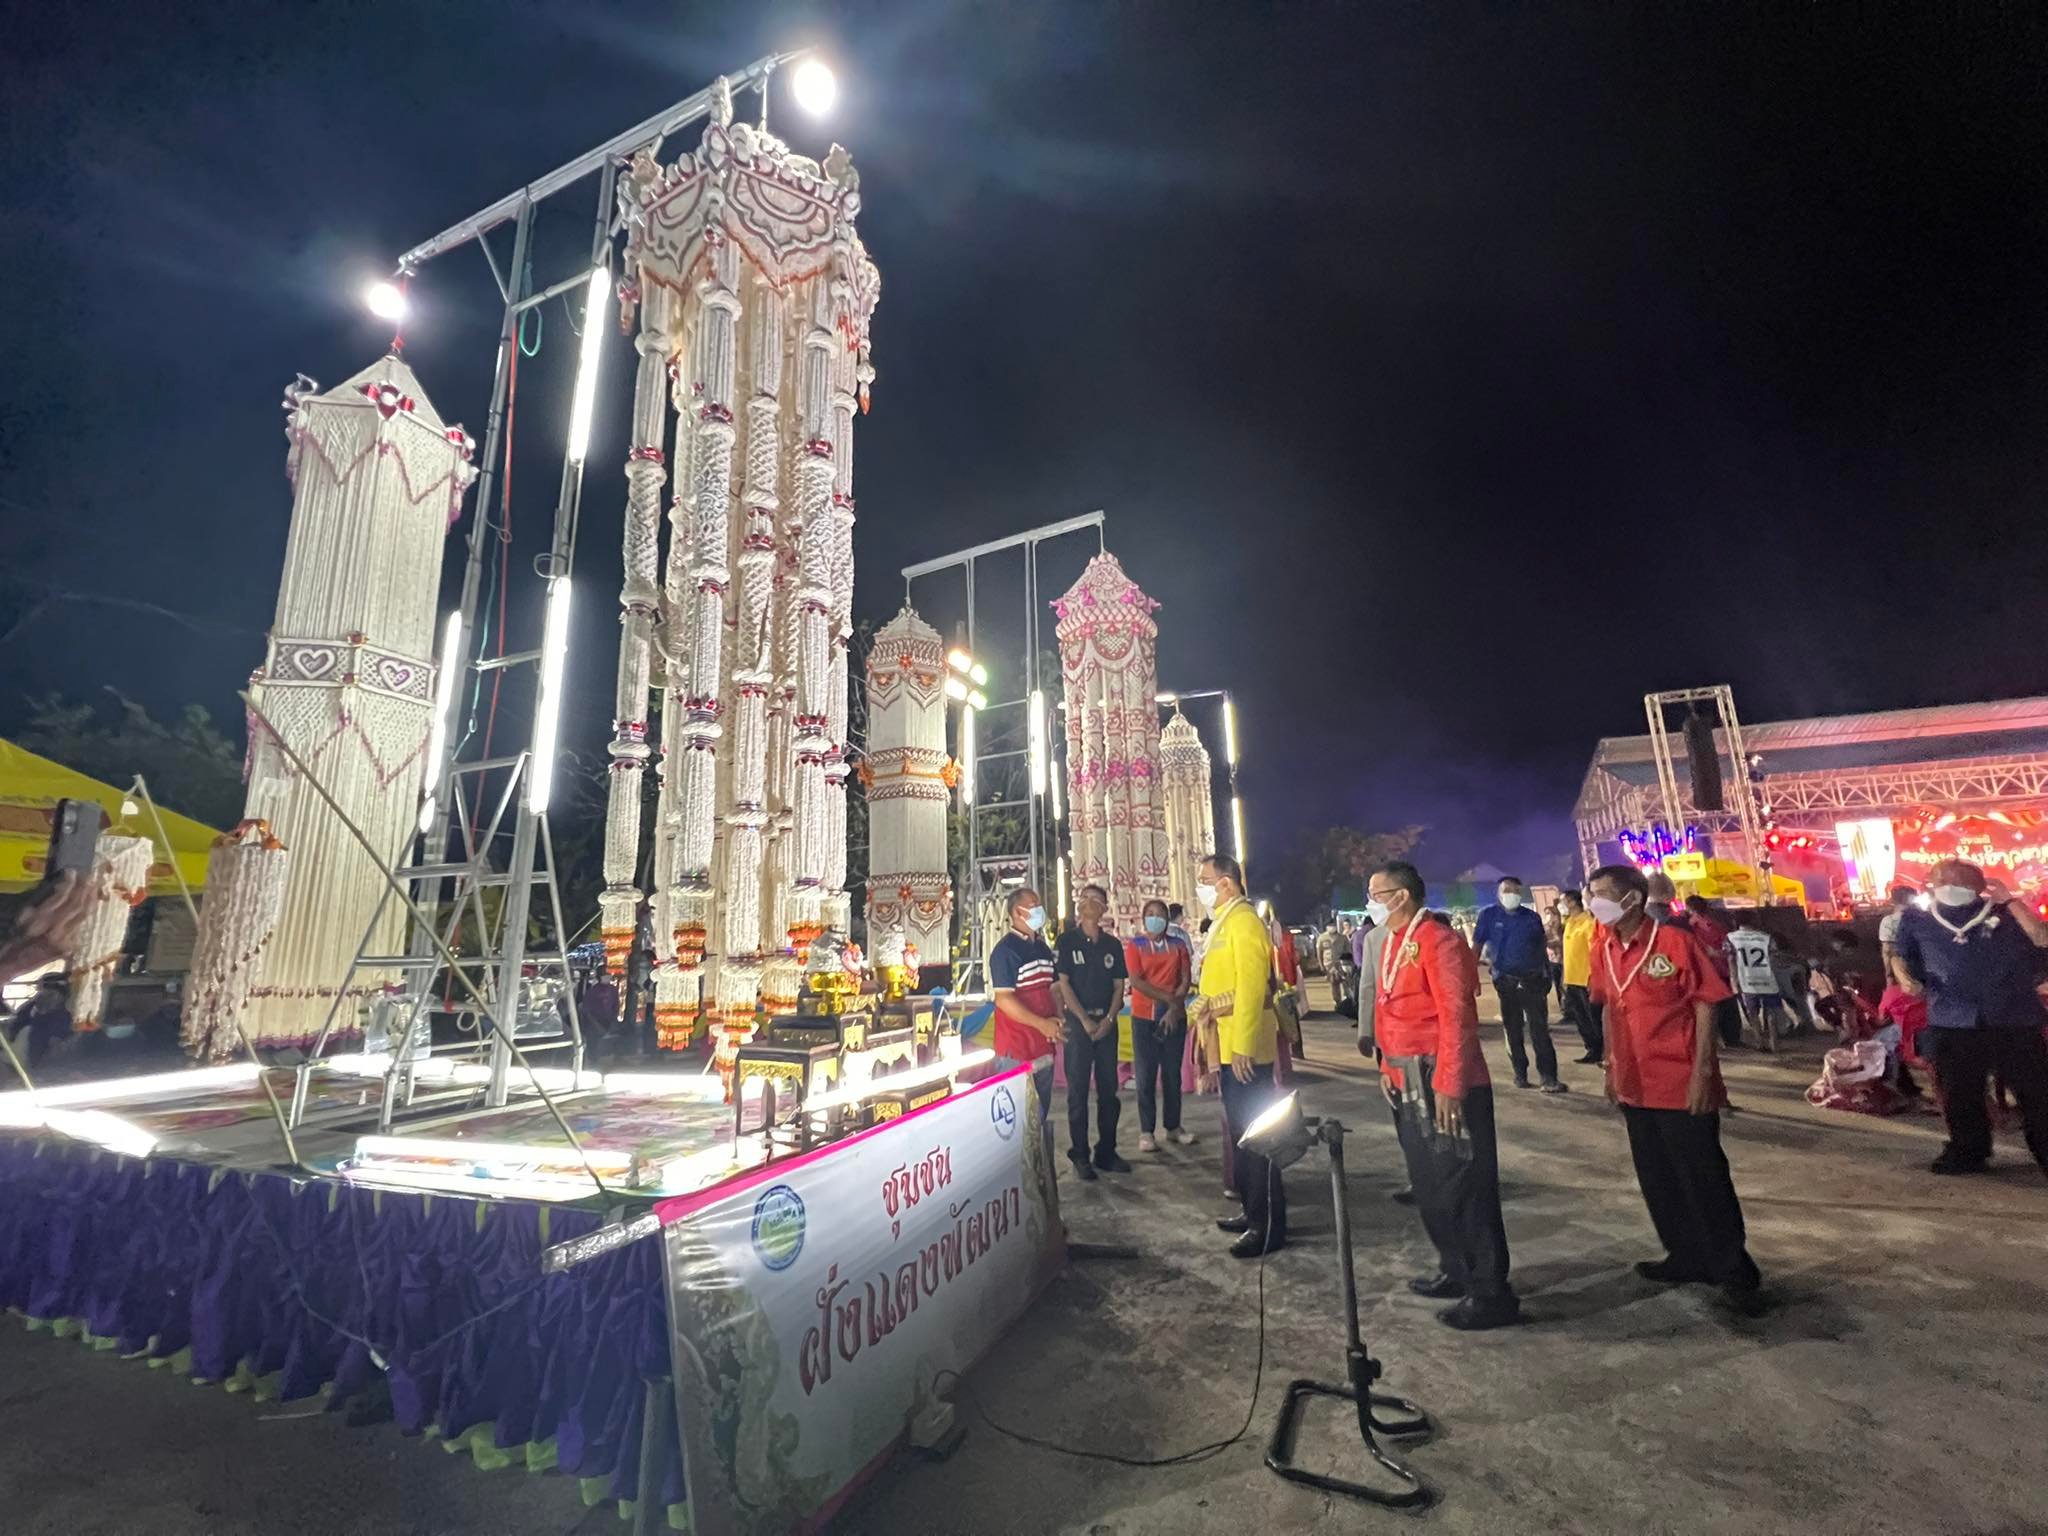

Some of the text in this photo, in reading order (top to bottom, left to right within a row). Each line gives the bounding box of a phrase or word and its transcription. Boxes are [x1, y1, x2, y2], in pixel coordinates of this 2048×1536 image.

[1738, 947, 1767, 967] 12
[882, 1145, 952, 1241] ชุมชน
[800, 1187, 1020, 1396] ฝั่งแดงพัฒนา
